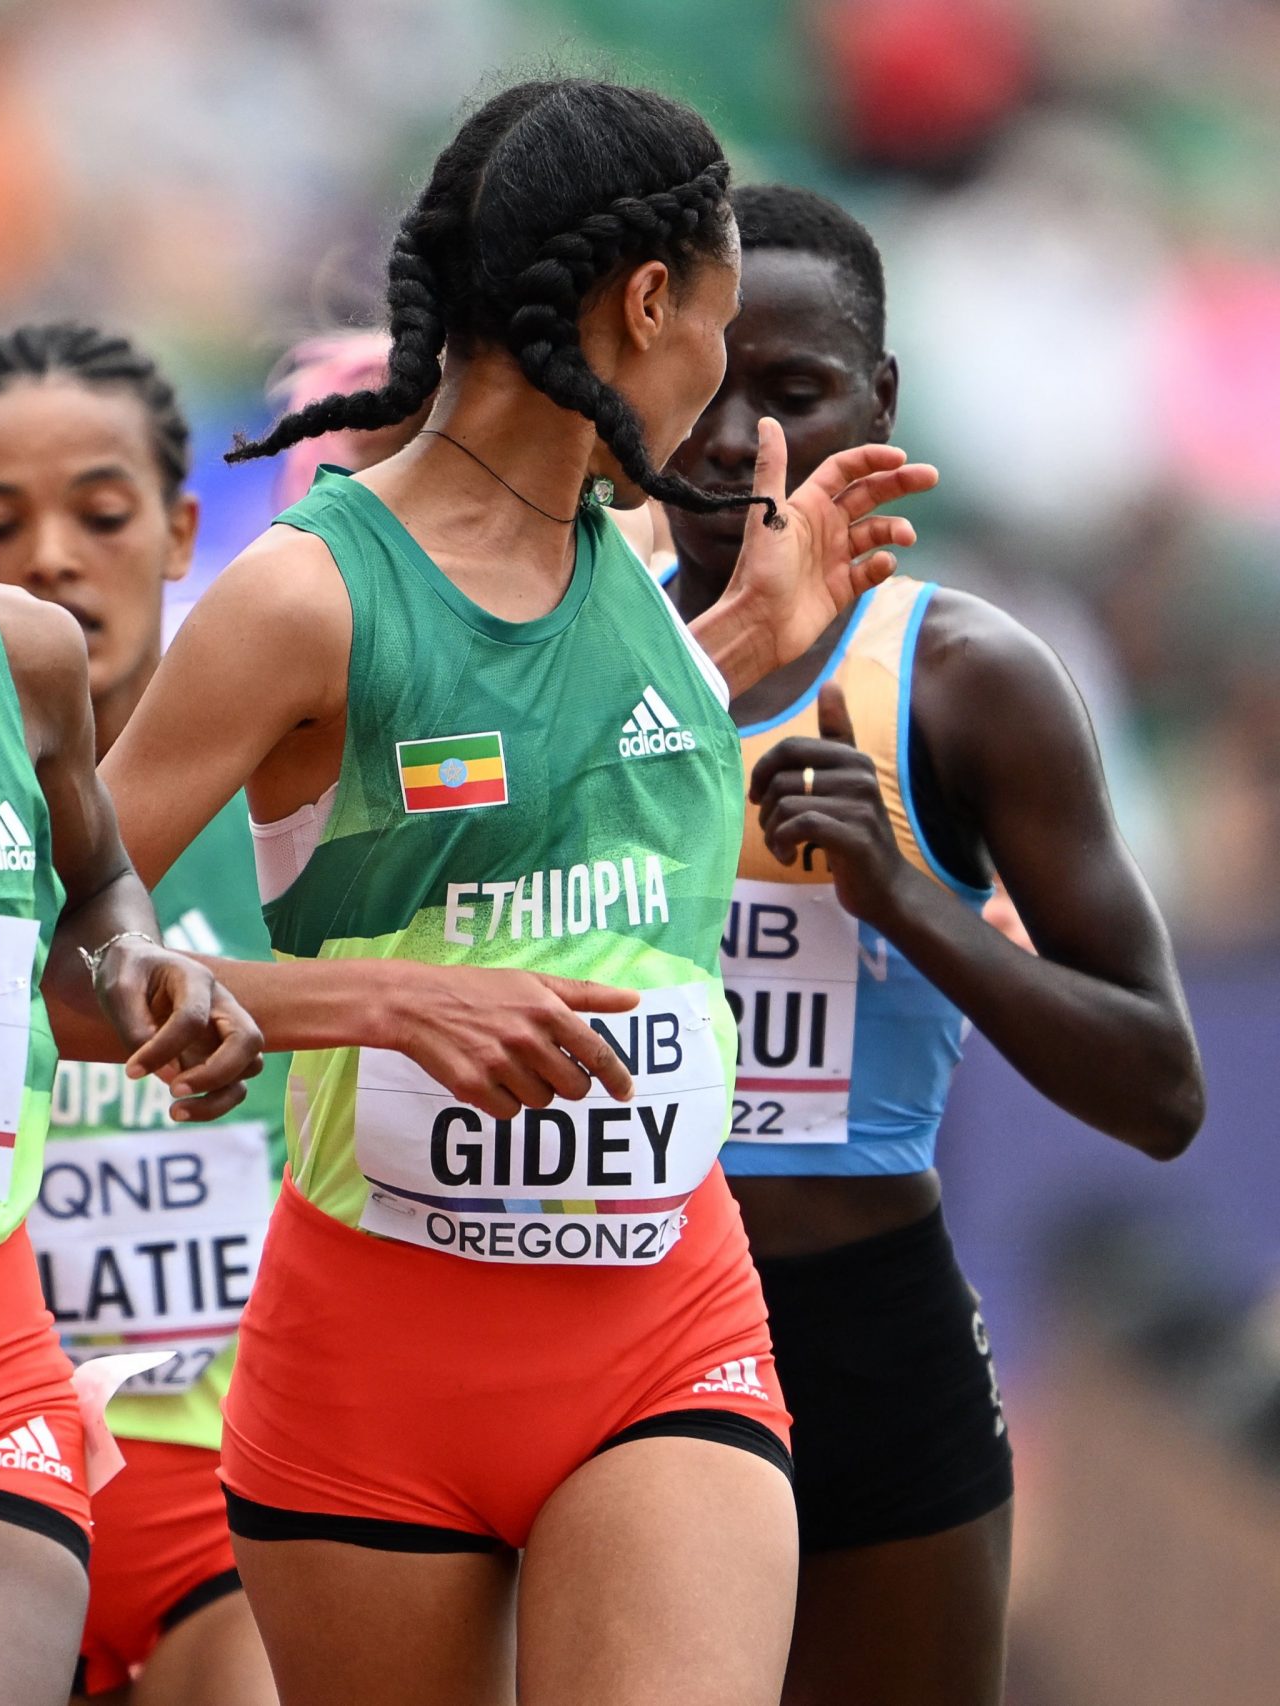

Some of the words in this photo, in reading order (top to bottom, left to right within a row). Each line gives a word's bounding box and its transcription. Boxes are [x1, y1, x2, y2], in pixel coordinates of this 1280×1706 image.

[619, 727, 696, 758] adidas
[444, 855, 670, 945] ETHIOPIA
[39, 1153, 208, 1220] QNB
[430, 1103, 679, 1187] GIDEY
[40, 1234, 250, 1322] LATIE
